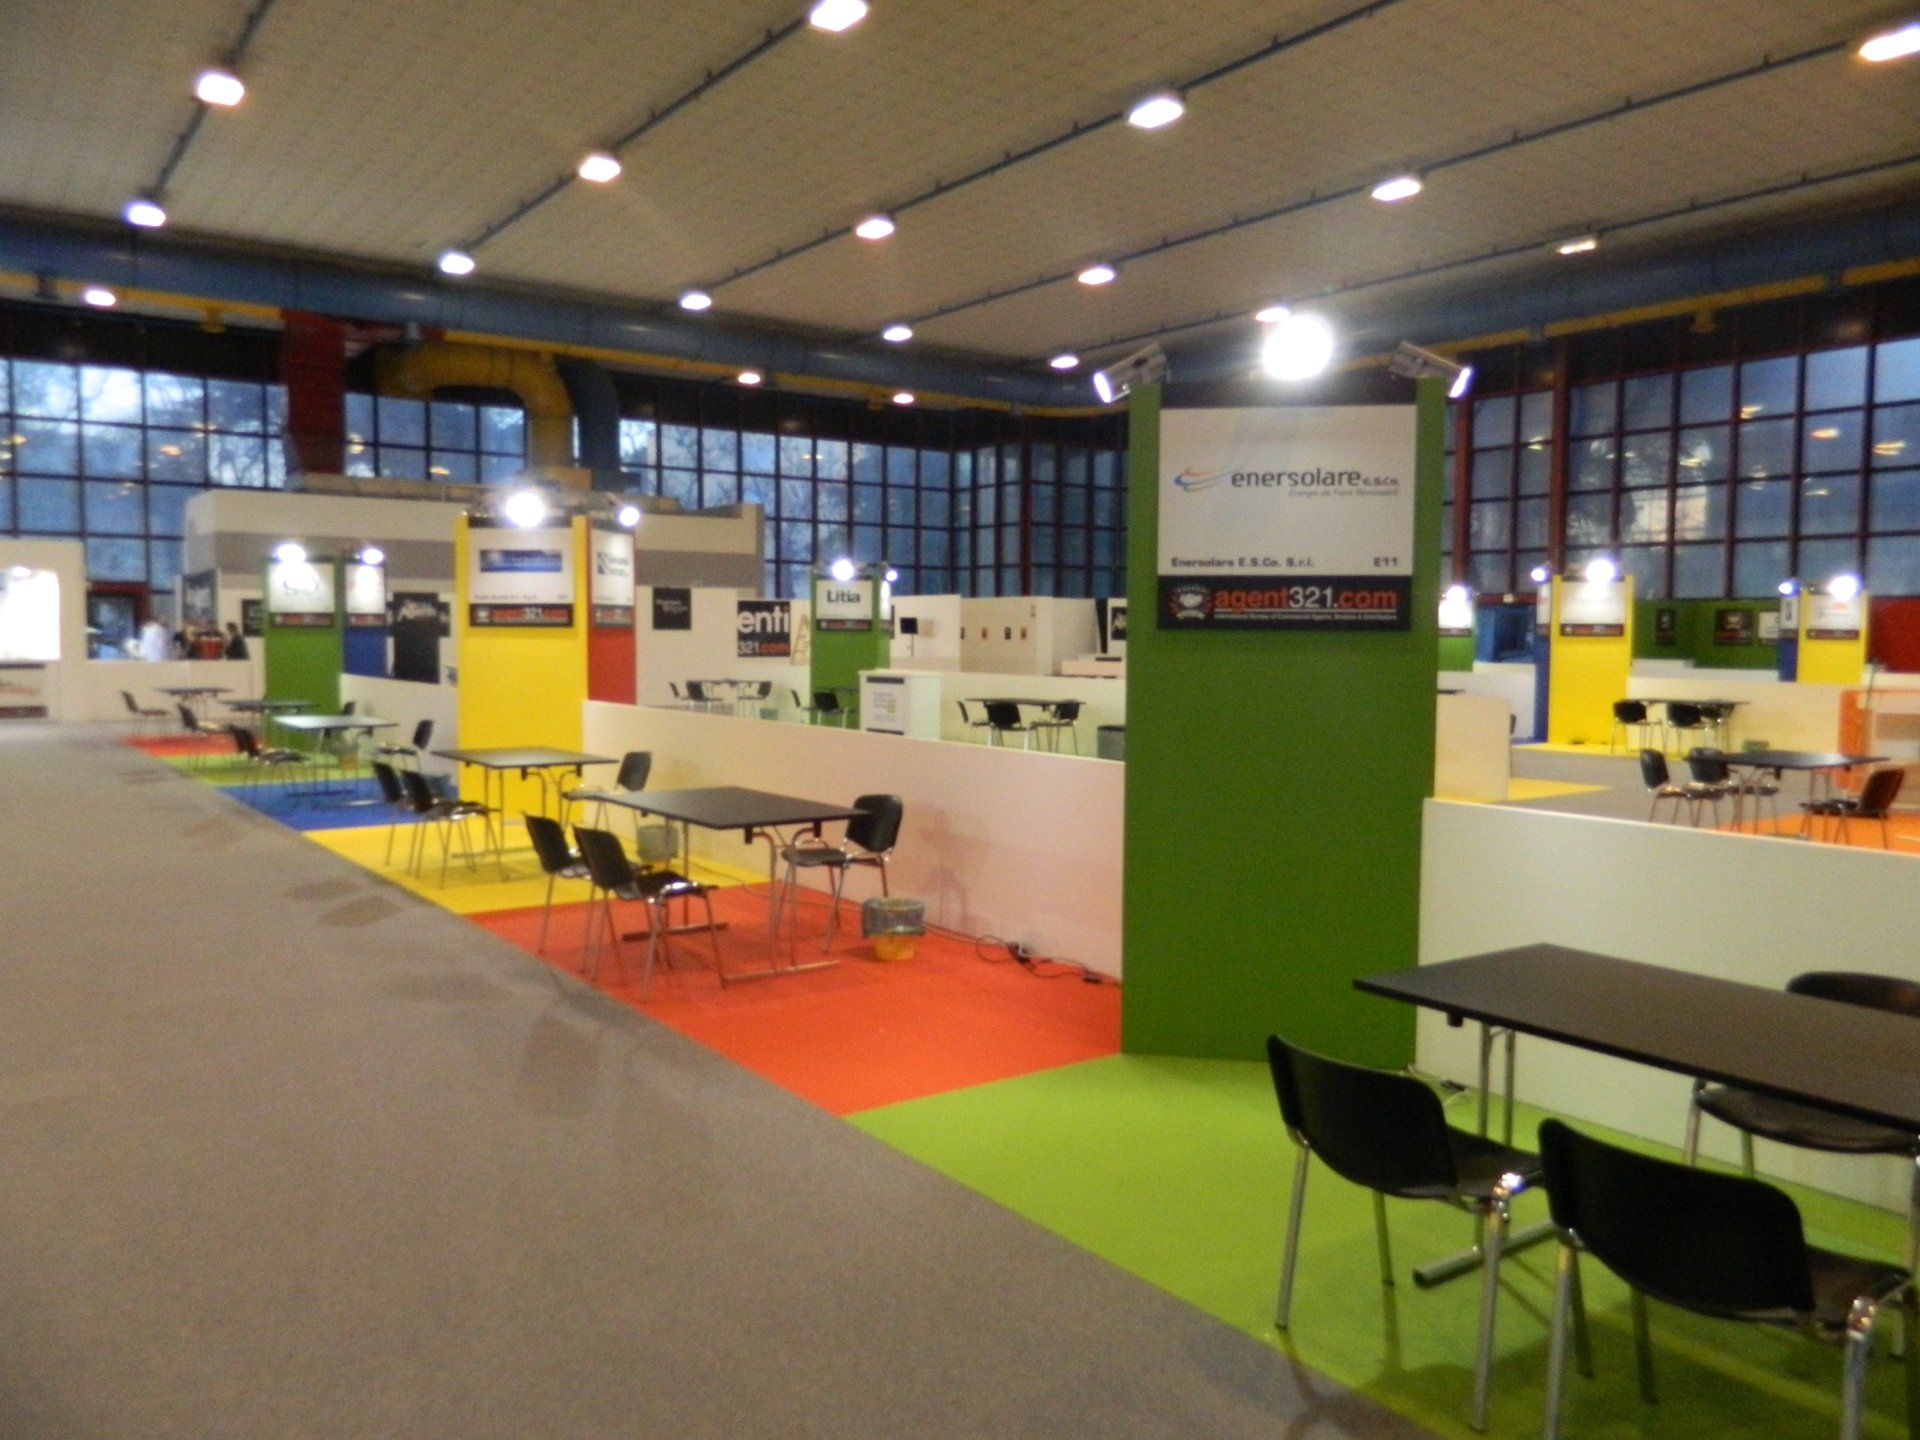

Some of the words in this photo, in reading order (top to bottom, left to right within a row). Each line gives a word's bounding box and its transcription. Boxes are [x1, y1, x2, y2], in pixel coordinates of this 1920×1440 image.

[1231, 467, 1361, 488] enersolare
[1171, 557, 1234, 568] Enersolare
[1373, 557, 1399, 568] E11
[826, 590, 861, 604] Litia
[1214, 586, 1398, 613] agent321.com
